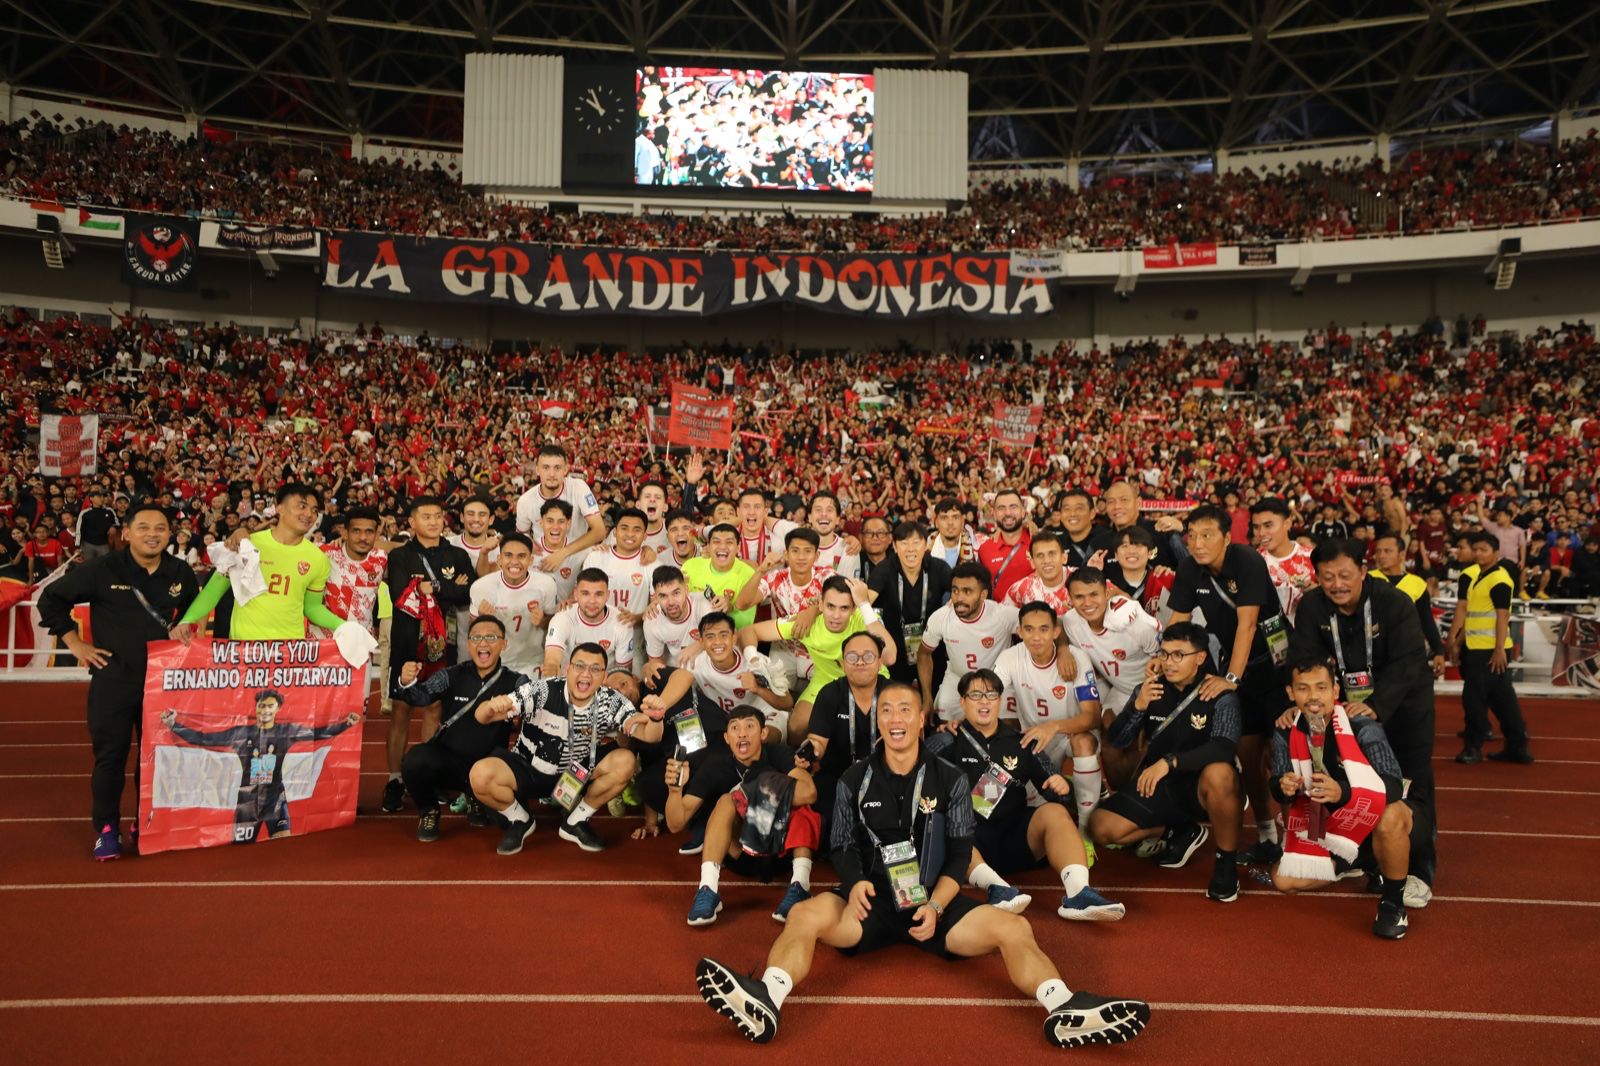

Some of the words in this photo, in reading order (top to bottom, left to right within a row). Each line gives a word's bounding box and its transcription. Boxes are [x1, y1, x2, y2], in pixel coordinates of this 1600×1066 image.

[390, 147, 457, 161] SEKTOR
[129, 257, 160, 281] GARUDA
[165, 263, 191, 282] QATAR
[322, 239, 411, 294] LA
[441, 245, 705, 312] GRANDE
[731, 253, 1054, 317] INDONESIA
[268, 573, 290, 595] 21
[613, 589, 629, 607] 14
[512, 615, 523, 632] 7
[213, 641, 240, 664] WE
[244, 641, 283, 664] LOVE
[287, 641, 320, 663] YOU
[966, 653, 977, 670] 2
[1100, 660, 1119, 677] 17
[163, 668, 240, 690] ERNANDO
[244, 668, 269, 687] ARI
[273, 667, 351, 688] SUTARYADI
[1090, 686, 1099, 698] C
[1006, 696, 1017, 713] 2
[1036, 698, 1049, 717] 5
[235, 826, 255, 842] 20
